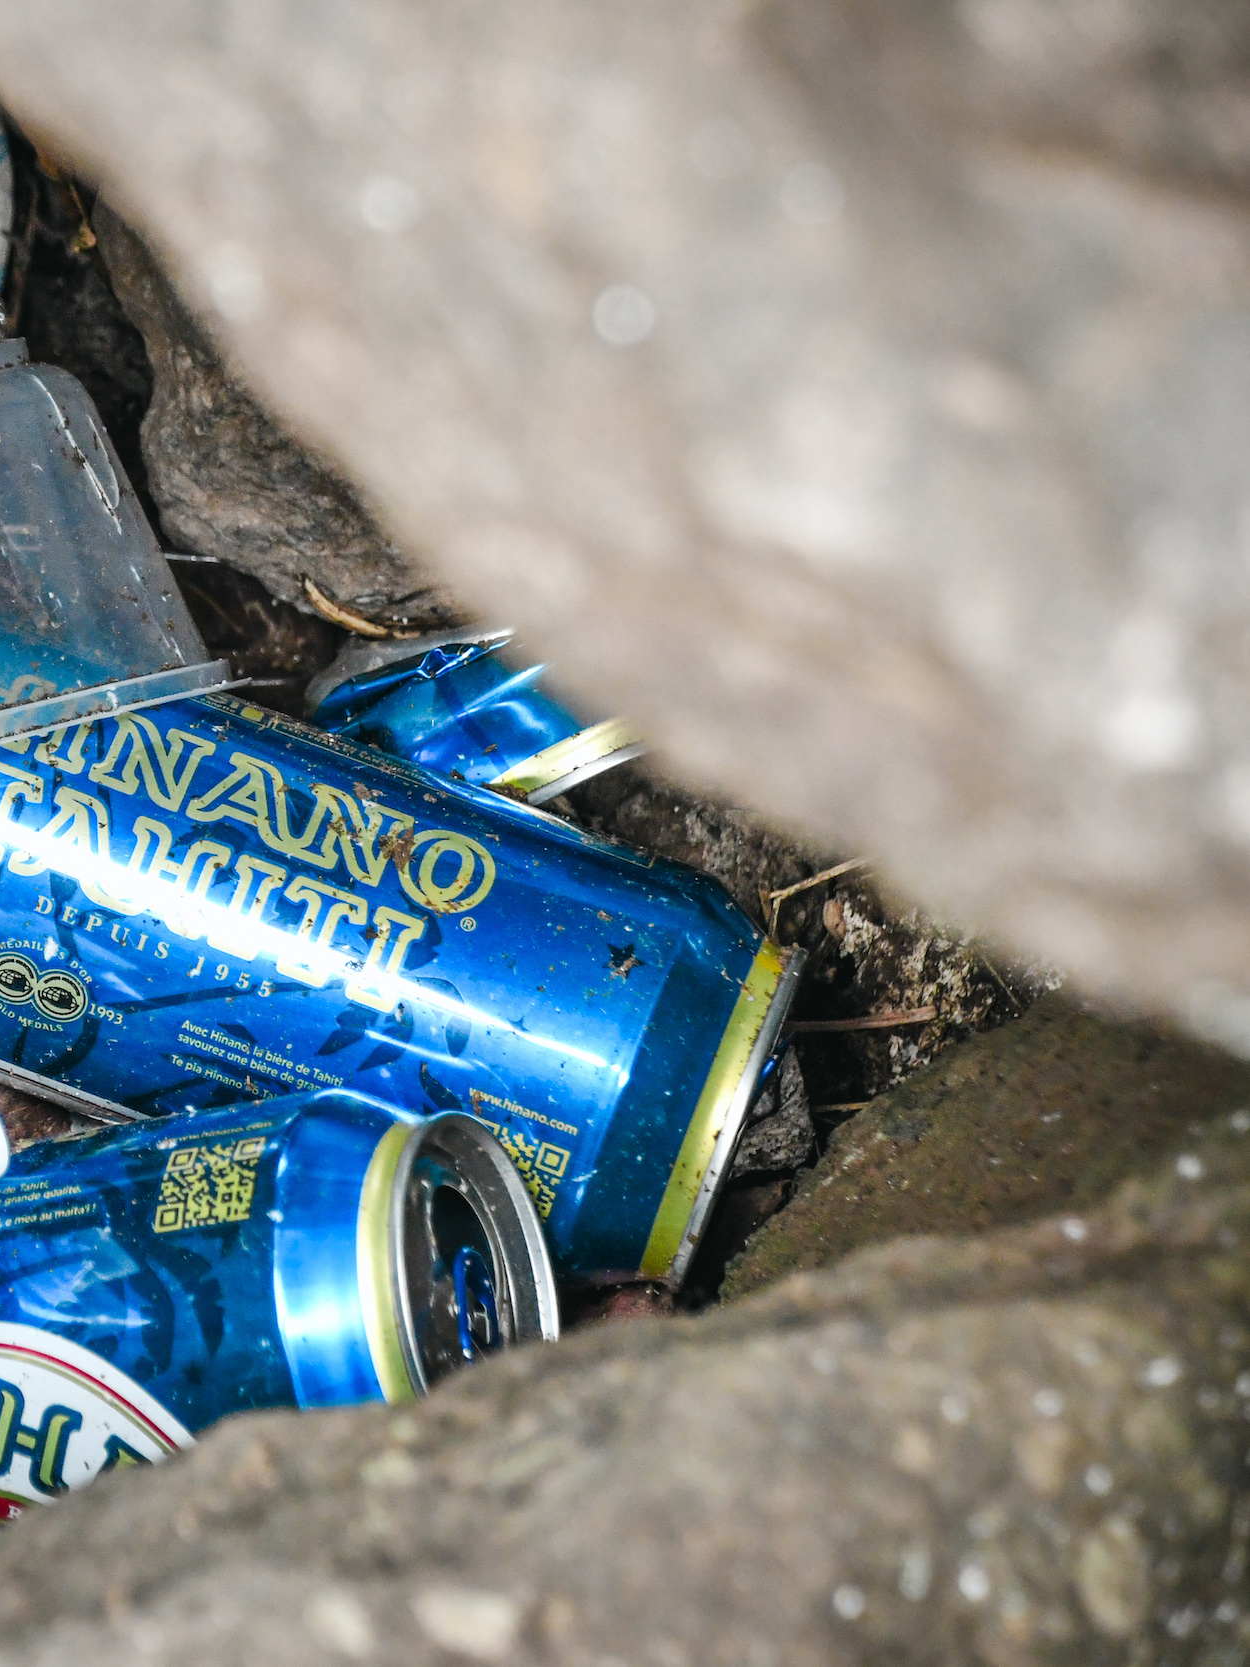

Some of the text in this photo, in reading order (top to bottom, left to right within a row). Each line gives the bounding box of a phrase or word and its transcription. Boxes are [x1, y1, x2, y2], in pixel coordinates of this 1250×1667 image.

[37, 895, 274, 997] DEPUIS 1955
[17, 1016, 64, 1032] MEDALS
[88, 1003, 124, 1026] 1993
[177, 1033, 225, 1057] savourez
[226, 1052, 247, 1065] une
[249, 1059, 279, 1076] bière
[279, 1070, 295, 1083] de
[181, 1019, 208, 1036] Avec
[209, 1030, 251, 1053] Hinano,
[253, 1046, 264, 1057] la
[264, 1050, 294, 1068] bière
[294, 1062, 310, 1075] de
[170, 1055, 184, 1066] Te
[185, 1061, 202, 1074] pia
[205, 1069, 242, 1088] Hinano
[469, 1086, 578, 1136] www.hinano.com
[4, 1191, 41, 1206] grande
[15, 1215, 37, 1224] mea
[39, 1212, 52, 1221] au
